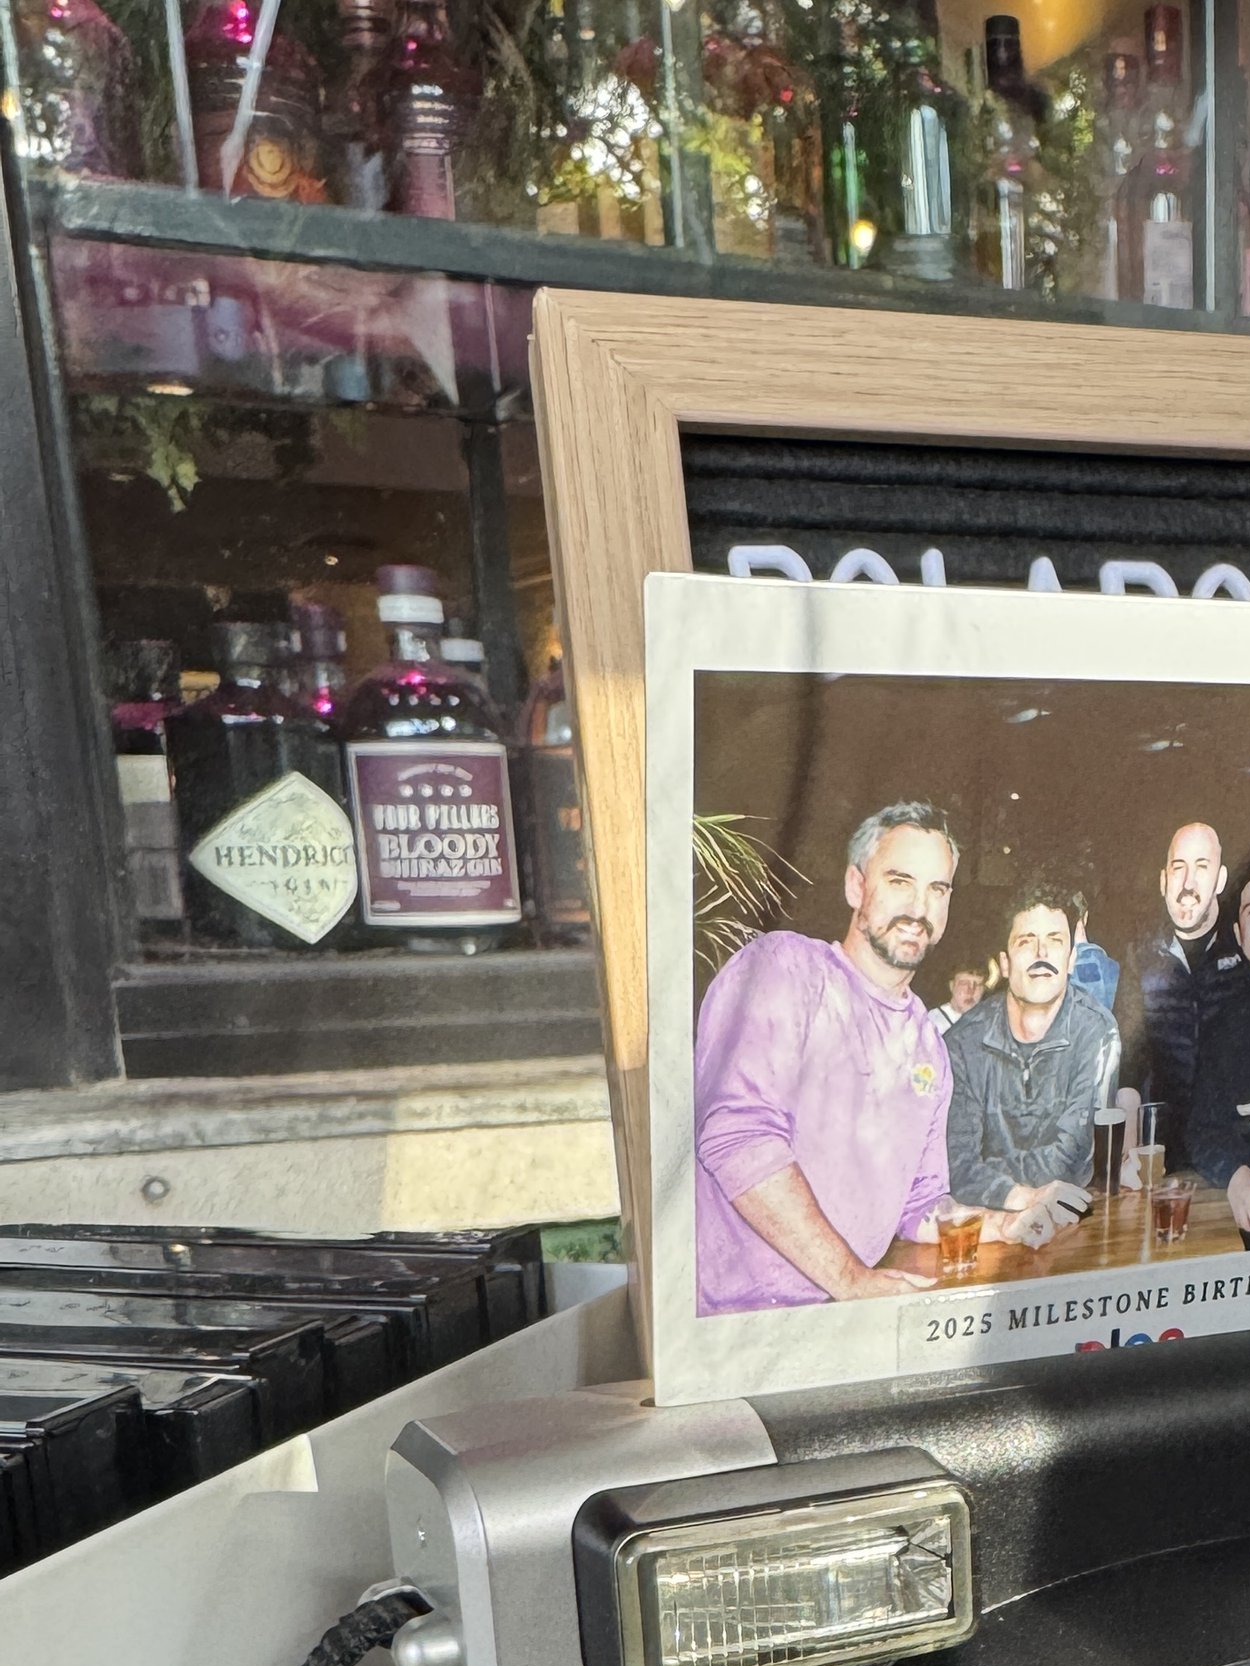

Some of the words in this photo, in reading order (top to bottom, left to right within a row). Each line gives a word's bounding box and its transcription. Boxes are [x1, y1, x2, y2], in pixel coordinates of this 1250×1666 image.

[378, 833, 500, 860] BLOODY
[926, 1312, 993, 1343] 2025
[1007, 1286, 1170, 1332] MILESTONE
